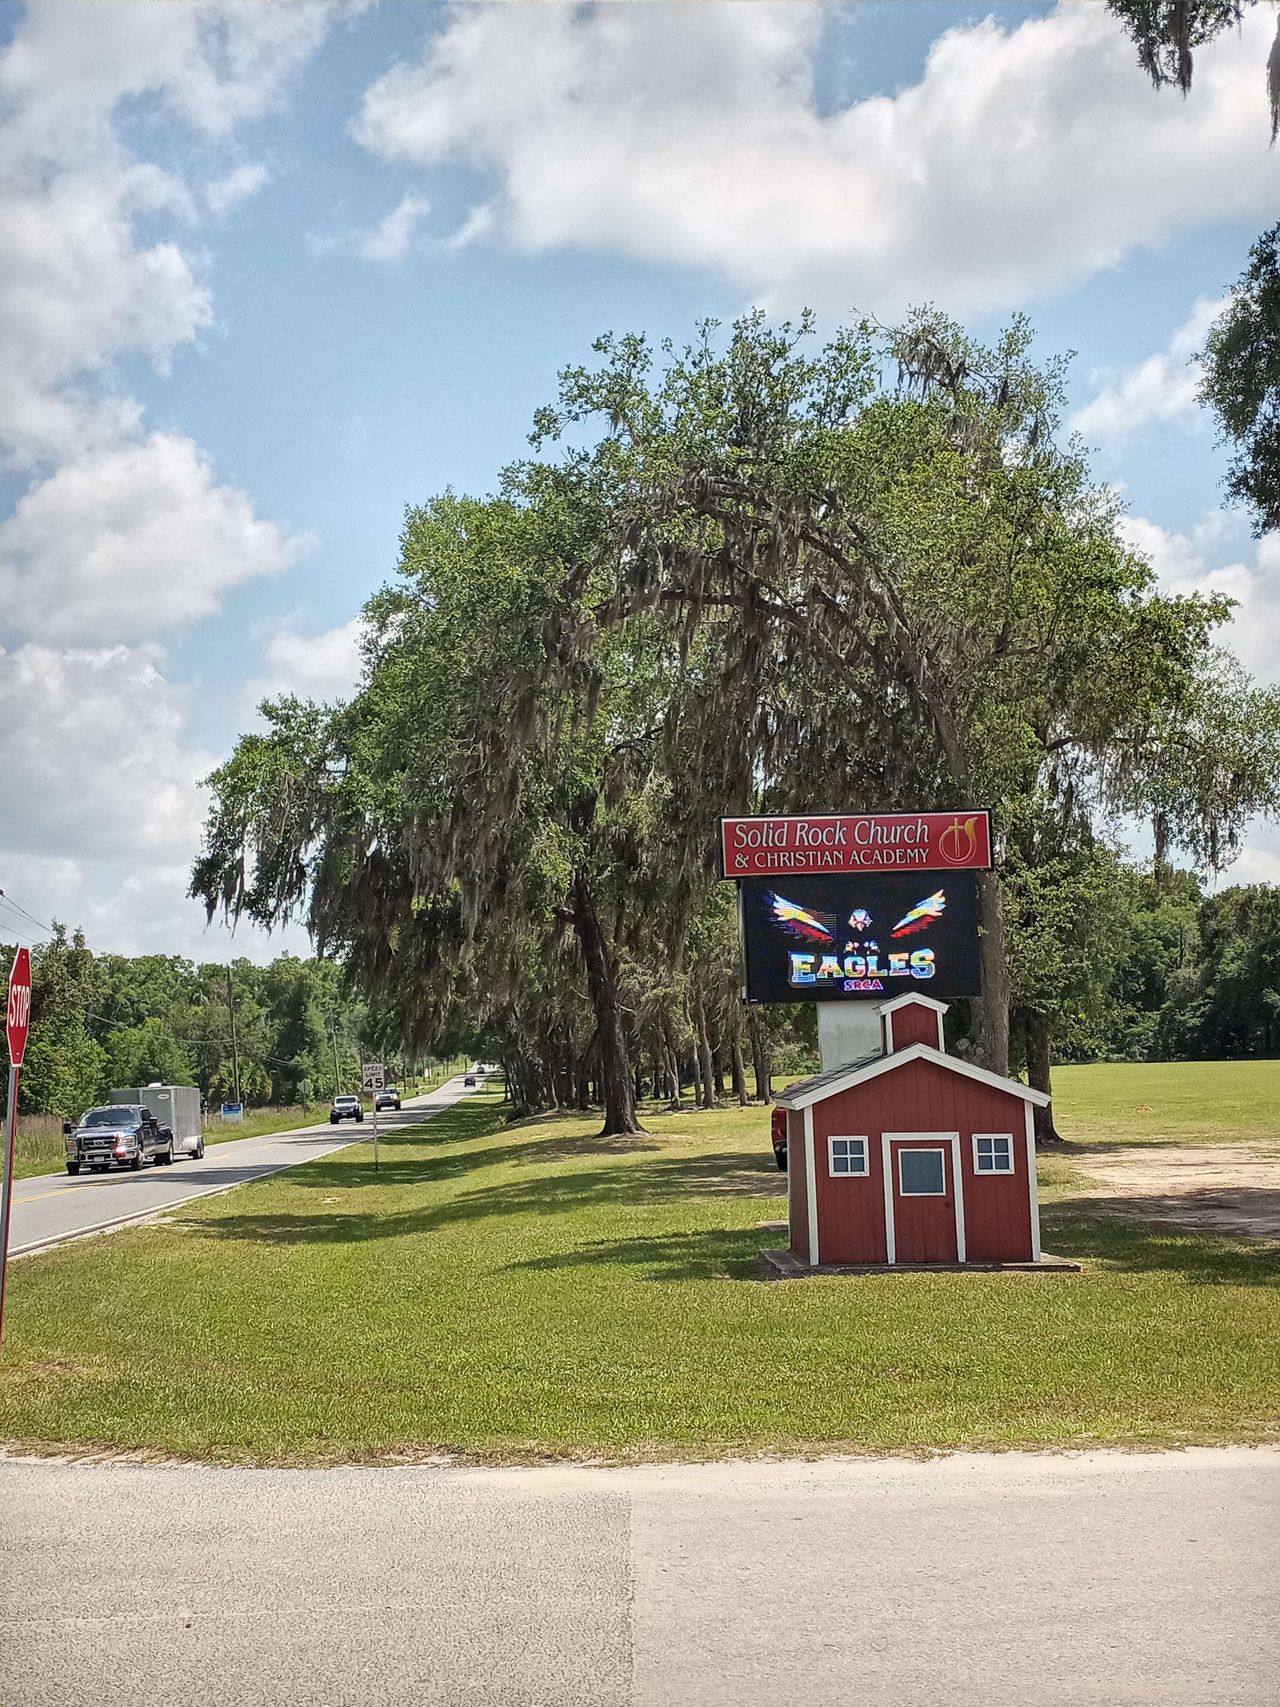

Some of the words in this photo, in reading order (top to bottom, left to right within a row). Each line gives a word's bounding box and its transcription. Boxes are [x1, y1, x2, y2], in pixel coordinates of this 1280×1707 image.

[733, 822, 788, 848] Solid
[794, 821, 847, 847] Rock
[854, 818, 930, 845] Church
[734, 853, 750, 869] &
[755, 850, 844, 868] CHRISTIAN
[849, 848, 930, 865] ACADEMY
[789, 948, 936, 983] EAGLES
[843, 979, 884, 992] SRCA
[10, 984, 30, 1027] STOP
[364, 1078, 383, 1089] 45
